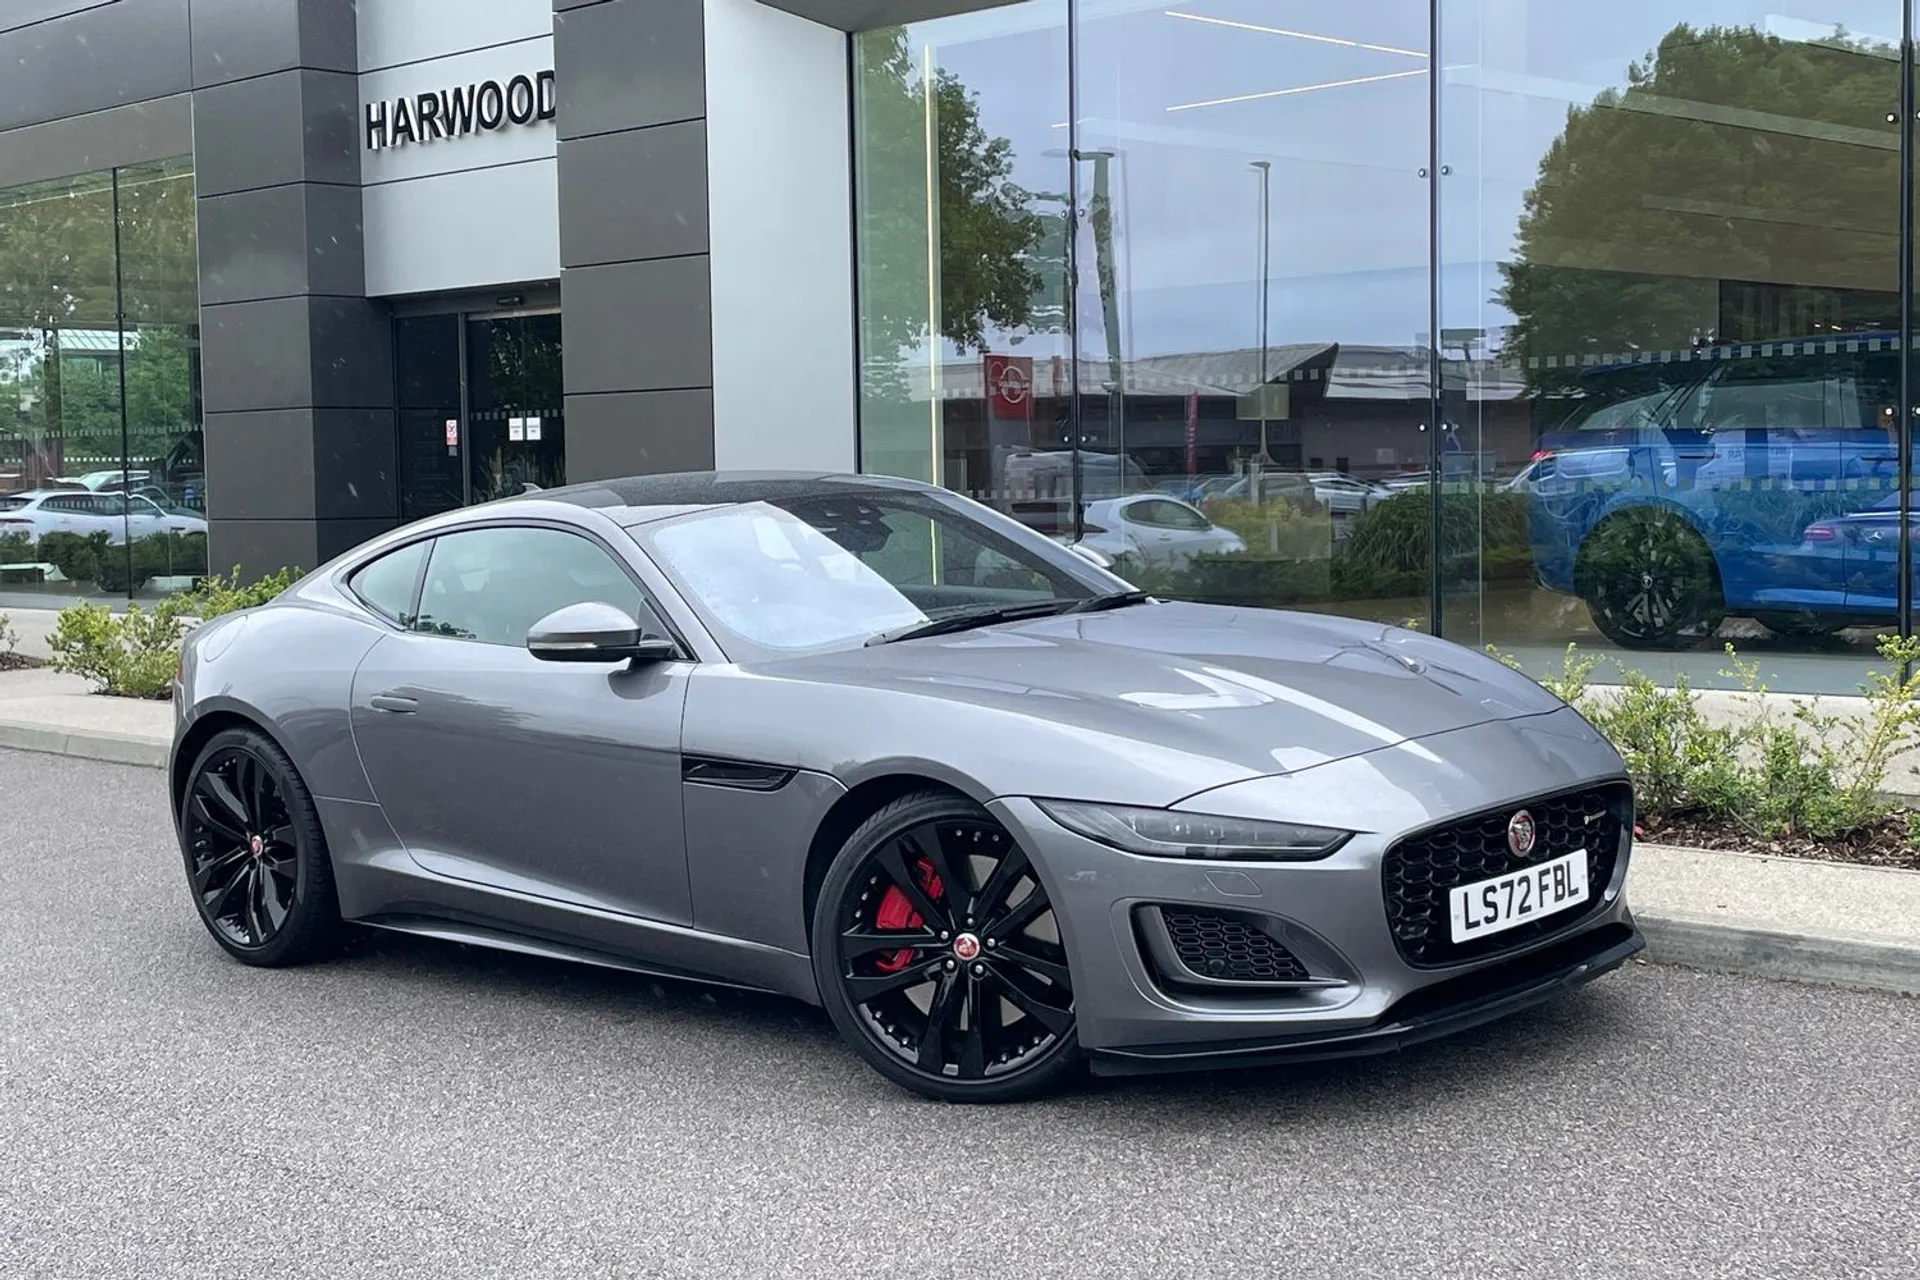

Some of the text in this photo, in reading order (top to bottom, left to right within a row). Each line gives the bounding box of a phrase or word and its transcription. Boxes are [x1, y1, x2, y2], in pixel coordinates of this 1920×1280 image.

[366, 70, 555, 149] HARWOOD
[1464, 861, 1579, 930] LS72 FBL
